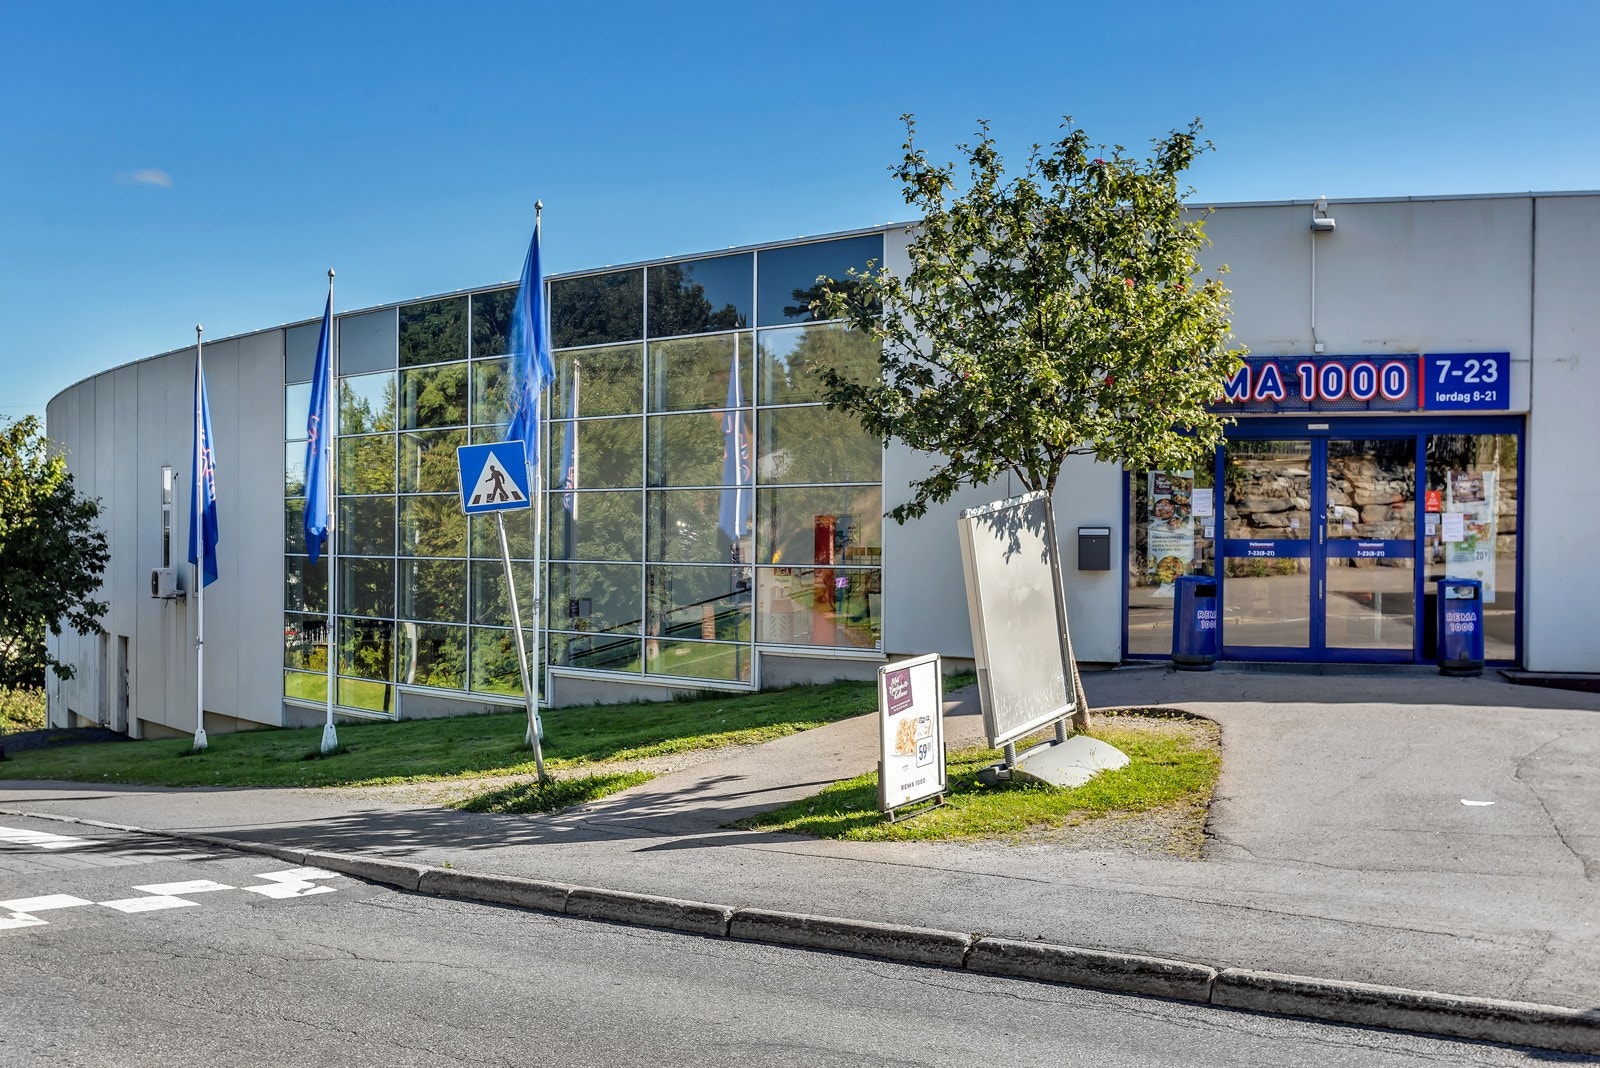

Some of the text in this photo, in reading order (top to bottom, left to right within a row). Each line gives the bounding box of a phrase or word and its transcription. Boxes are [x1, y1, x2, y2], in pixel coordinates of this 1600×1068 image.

[1435, 359, 1499, 384] 7-23
[1213, 360, 1410, 402] MA 1000
[1435, 391, 1498, 403] lørdag 8-21
[1197, 610, 1217, 619] REM
[1446, 612, 1477, 622] REMA
[1450, 622, 1475, 632] 1000
[919, 743, 927, 760] 59
[901, 777, 926, 791] REMA 1000
